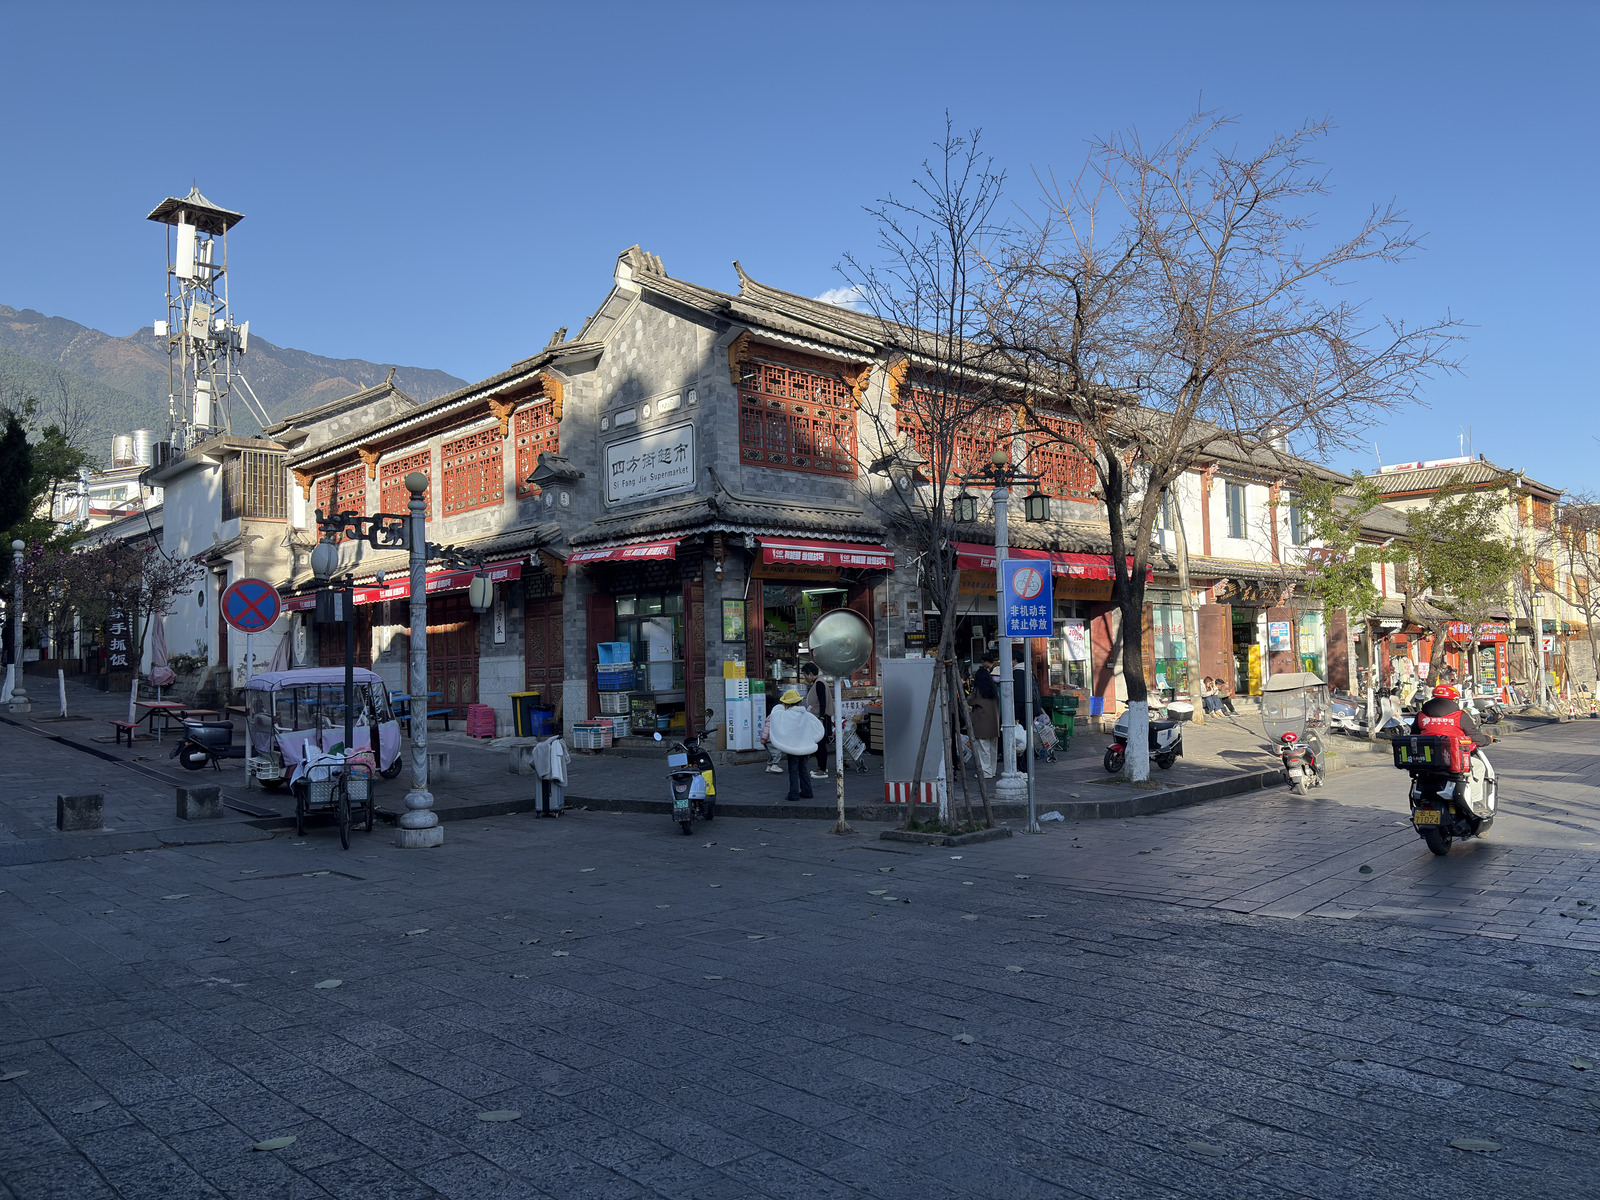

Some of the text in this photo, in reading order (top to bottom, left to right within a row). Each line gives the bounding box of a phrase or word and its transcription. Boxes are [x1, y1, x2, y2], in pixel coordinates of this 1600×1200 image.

[612, 443, 689, 476] 四方街超市
[613, 465, 689, 490] Si Fang Jie Supermarket
[797, 567, 834, 575] SUPERMARKET
[1010, 605, 1047, 617] 非机动车
[1010, 618, 1048, 630] 禁止停放
